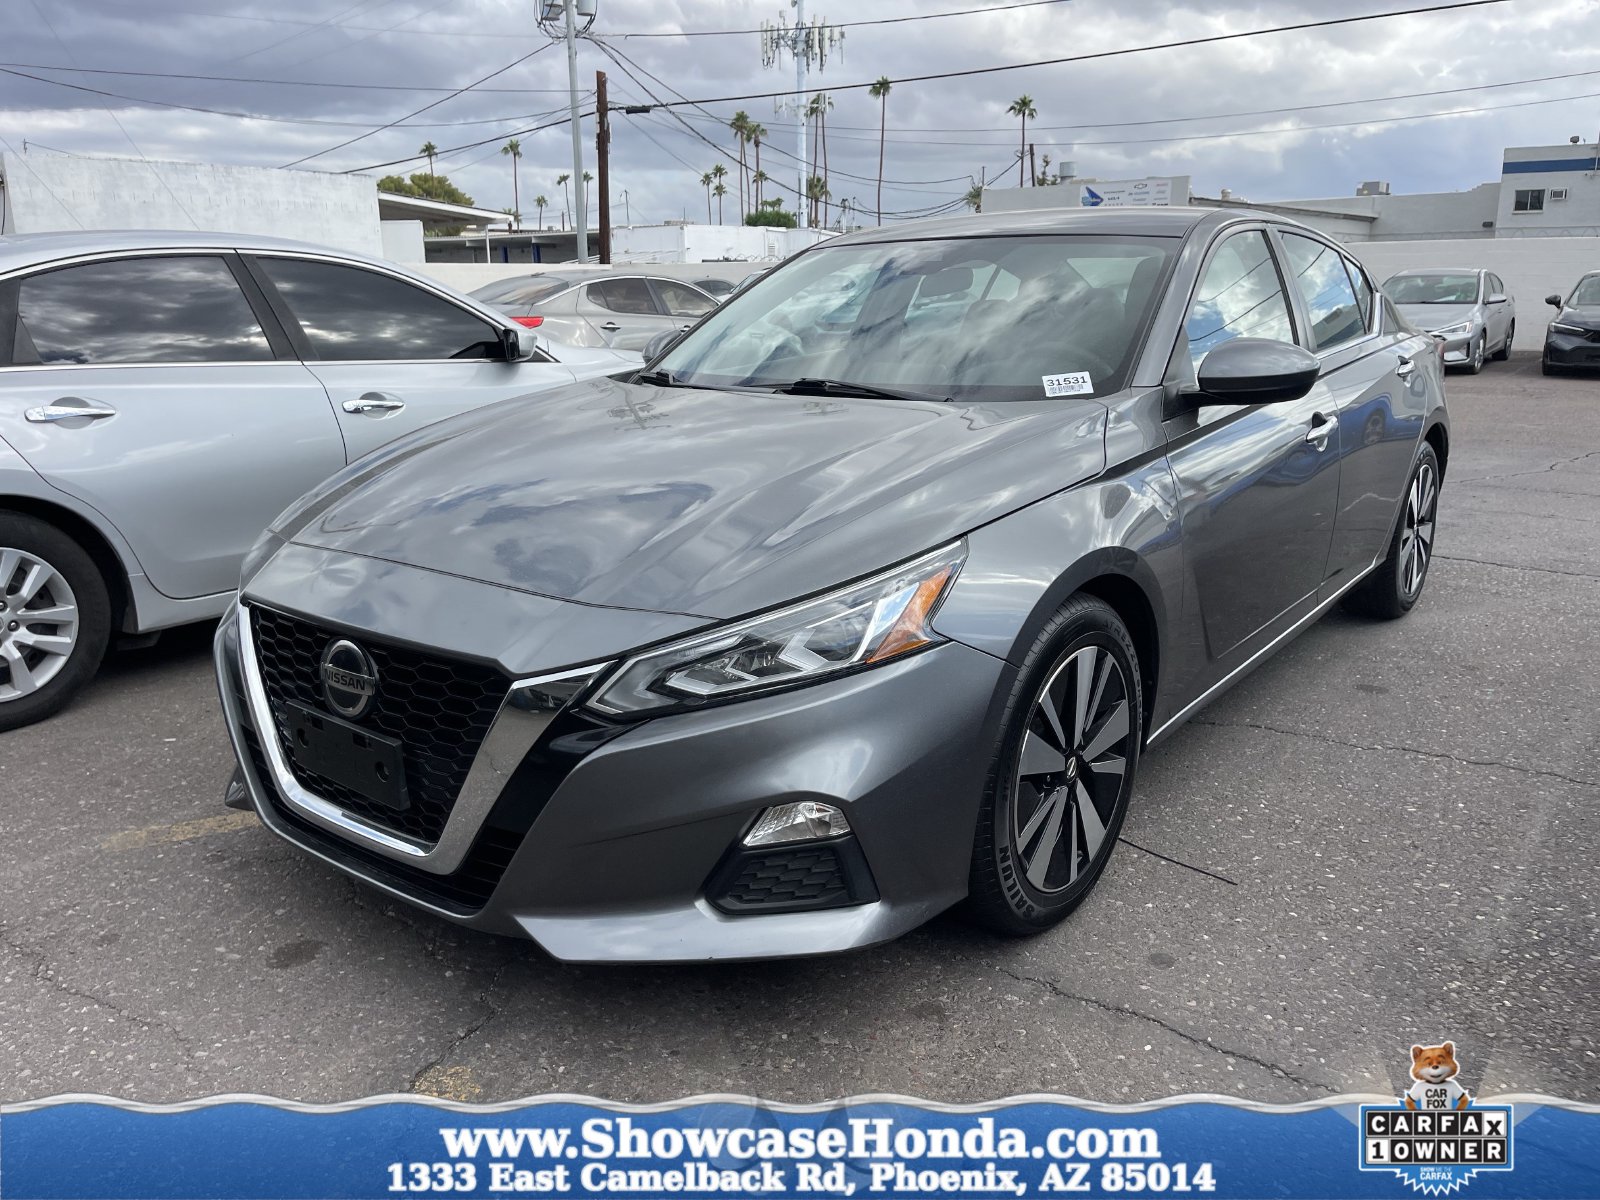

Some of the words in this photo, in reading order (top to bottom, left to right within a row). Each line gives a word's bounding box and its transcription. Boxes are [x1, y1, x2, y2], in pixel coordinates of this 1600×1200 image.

[1046, 375, 1088, 387] 31531
[324, 668, 366, 691] NISSAN
[998, 845, 1036, 919] SAILUN
